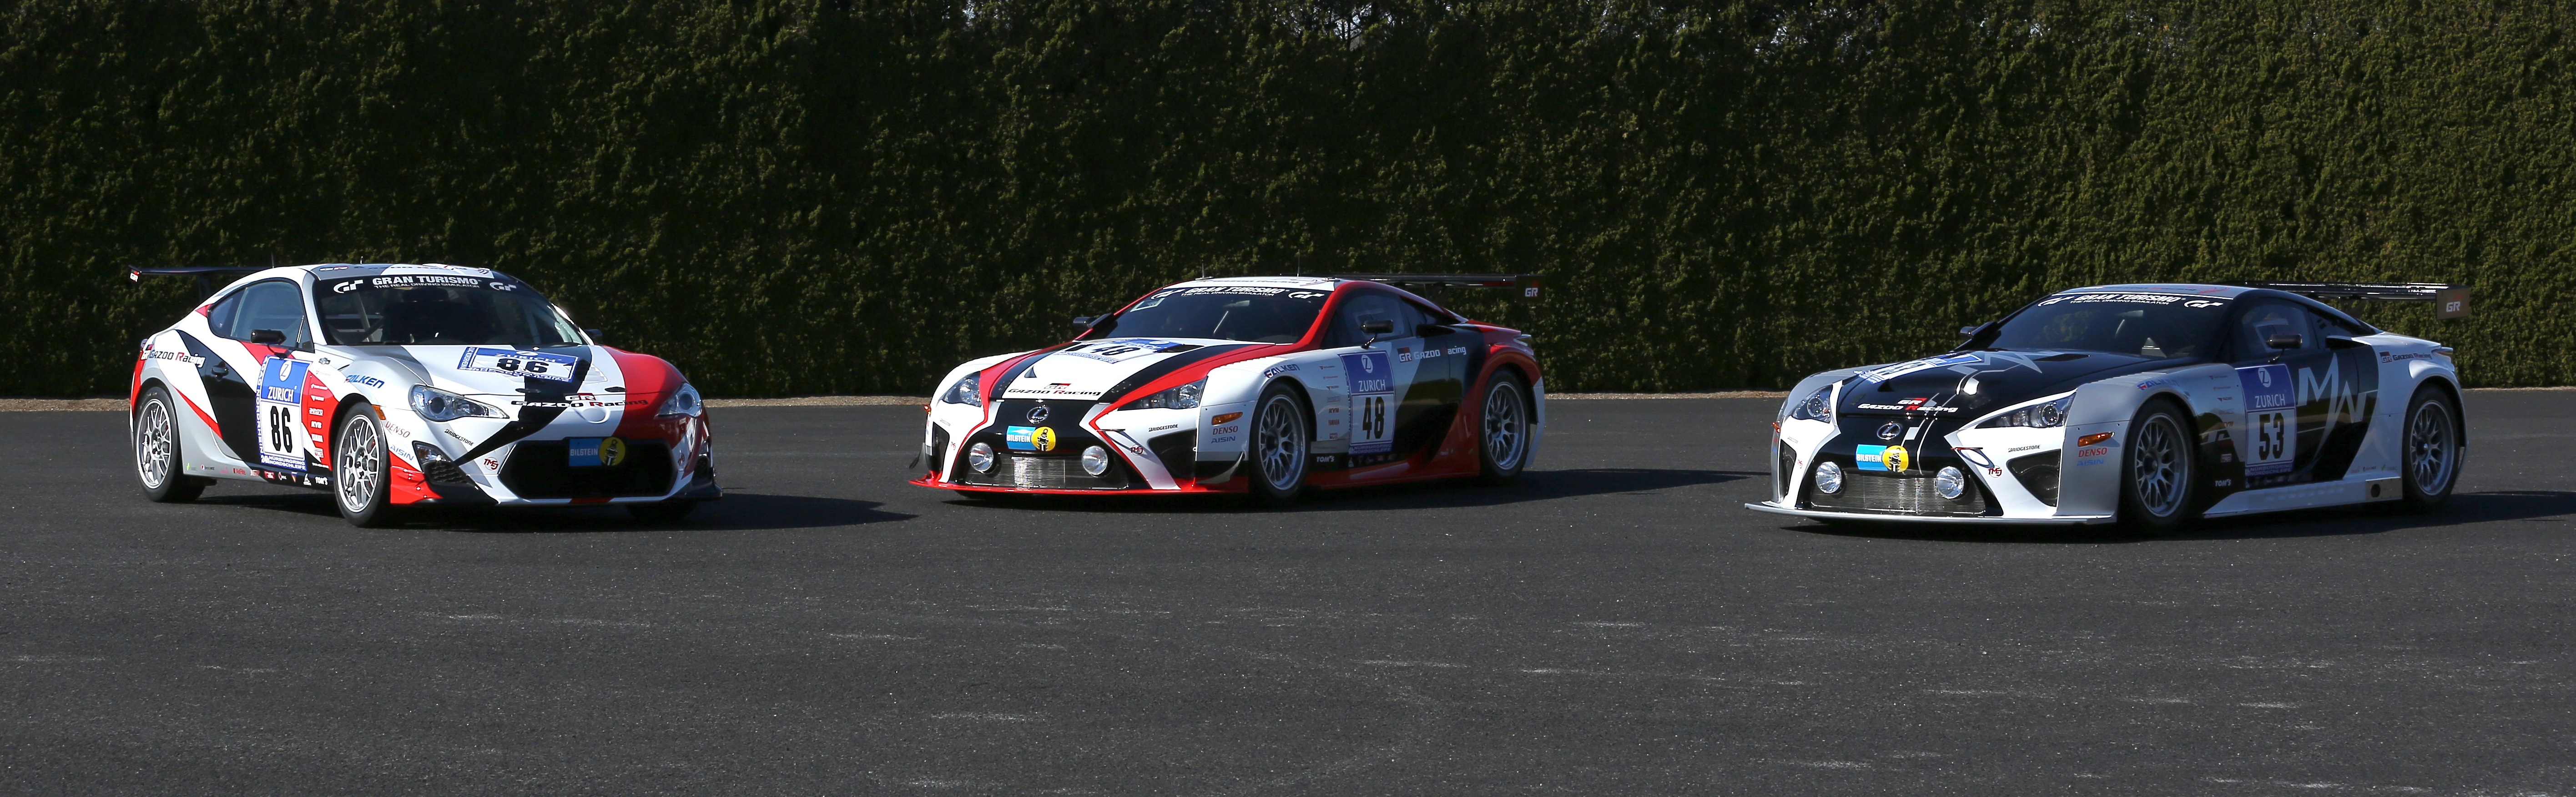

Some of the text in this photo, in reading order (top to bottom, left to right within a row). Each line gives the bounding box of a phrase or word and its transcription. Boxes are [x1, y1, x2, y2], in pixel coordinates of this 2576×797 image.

[373, 276, 478, 285] GRAN TURISMO
[1525, 288, 1538, 297] GR
[2446, 301, 2460, 312] GR
[1399, 353, 1412, 362] GR
[1414, 349, 1440, 359] GAZOO
[497, 358, 549, 373] 86
[1264, 364, 1301, 378] FALKEN
[1358, 379, 1386, 392] ZURICH
[267, 386, 294, 402] ZURICH
[2255, 394, 2286, 408] ZURICH
[1362, 396, 1385, 439] 48
[270, 406, 292, 453] 86
[385, 421, 410, 438] DENSO
[1149, 424, 1179, 432] BRIDGESTONE
[1212, 425, 1239, 435] DENSO
[444, 429, 474, 446] BRIDGESTONE
[1007, 434, 1031, 443] BILSTEIN
[1211, 436, 1236, 444] AISIN
[2258, 413, 2284, 460] 53
[390, 444, 414, 461] AISIN
[570, 448, 598, 456] BILSTEIN
[2008, 444, 2041, 453] BRIDGESTONE
[2078, 447, 2108, 458] DENSO
[1856, 454, 1882, 463] BILSTEIN
[2215, 479, 2231, 487] TOM'S
